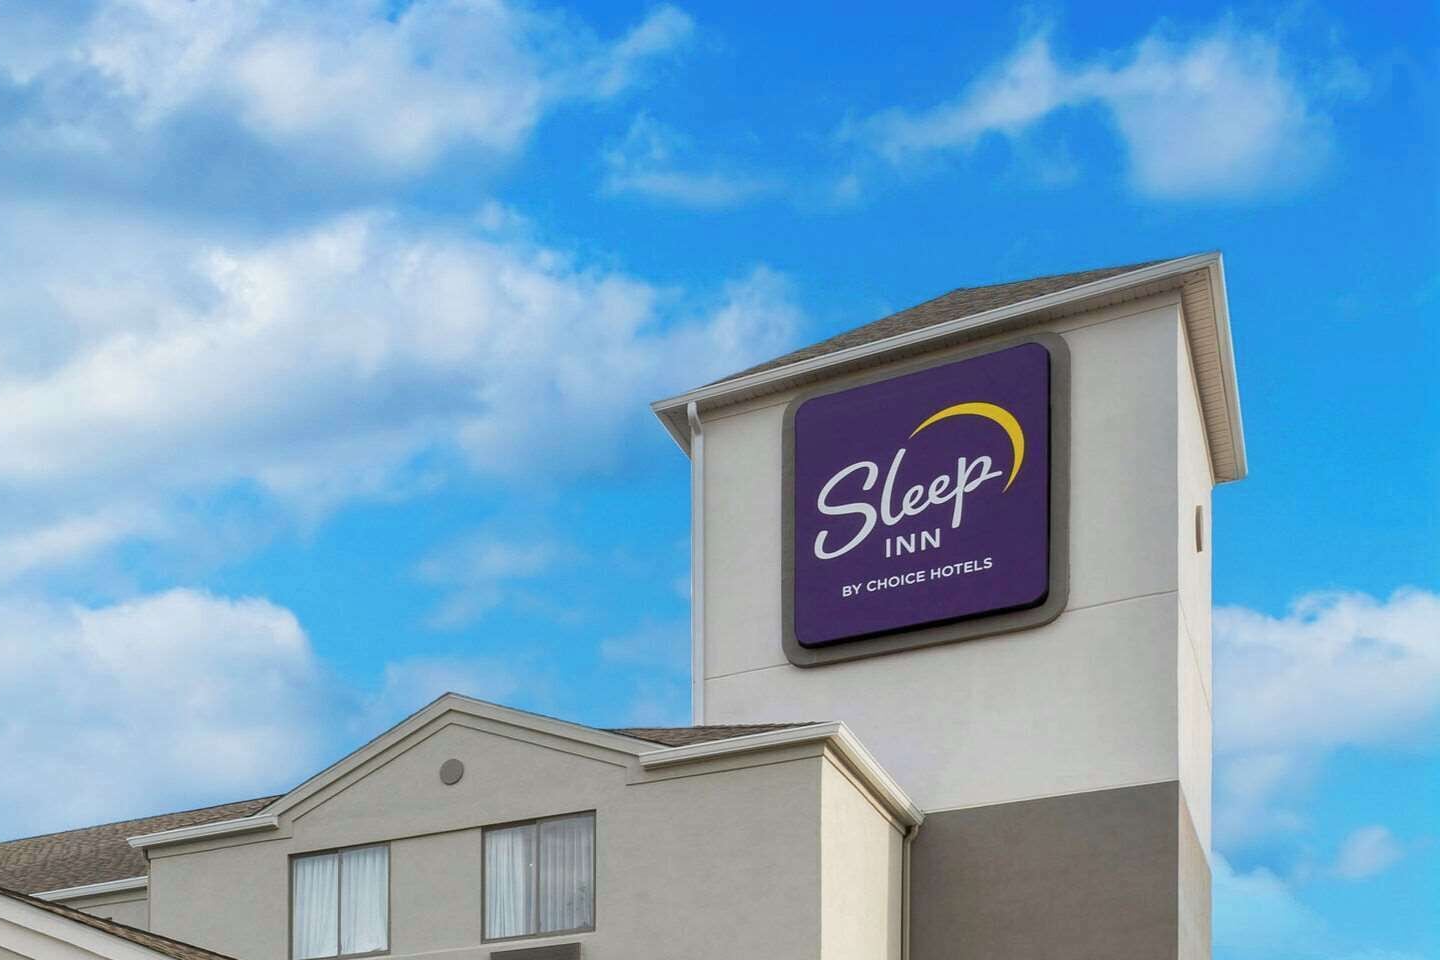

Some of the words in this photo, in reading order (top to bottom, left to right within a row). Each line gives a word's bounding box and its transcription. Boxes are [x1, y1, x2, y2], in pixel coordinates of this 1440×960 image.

[814, 448, 1003, 560] Sleep
[885, 528, 941, 558] INN
[842, 583, 862, 598] BY
[866, 570, 926, 592] CHOICE
[930, 557, 993, 580] HOTELS
